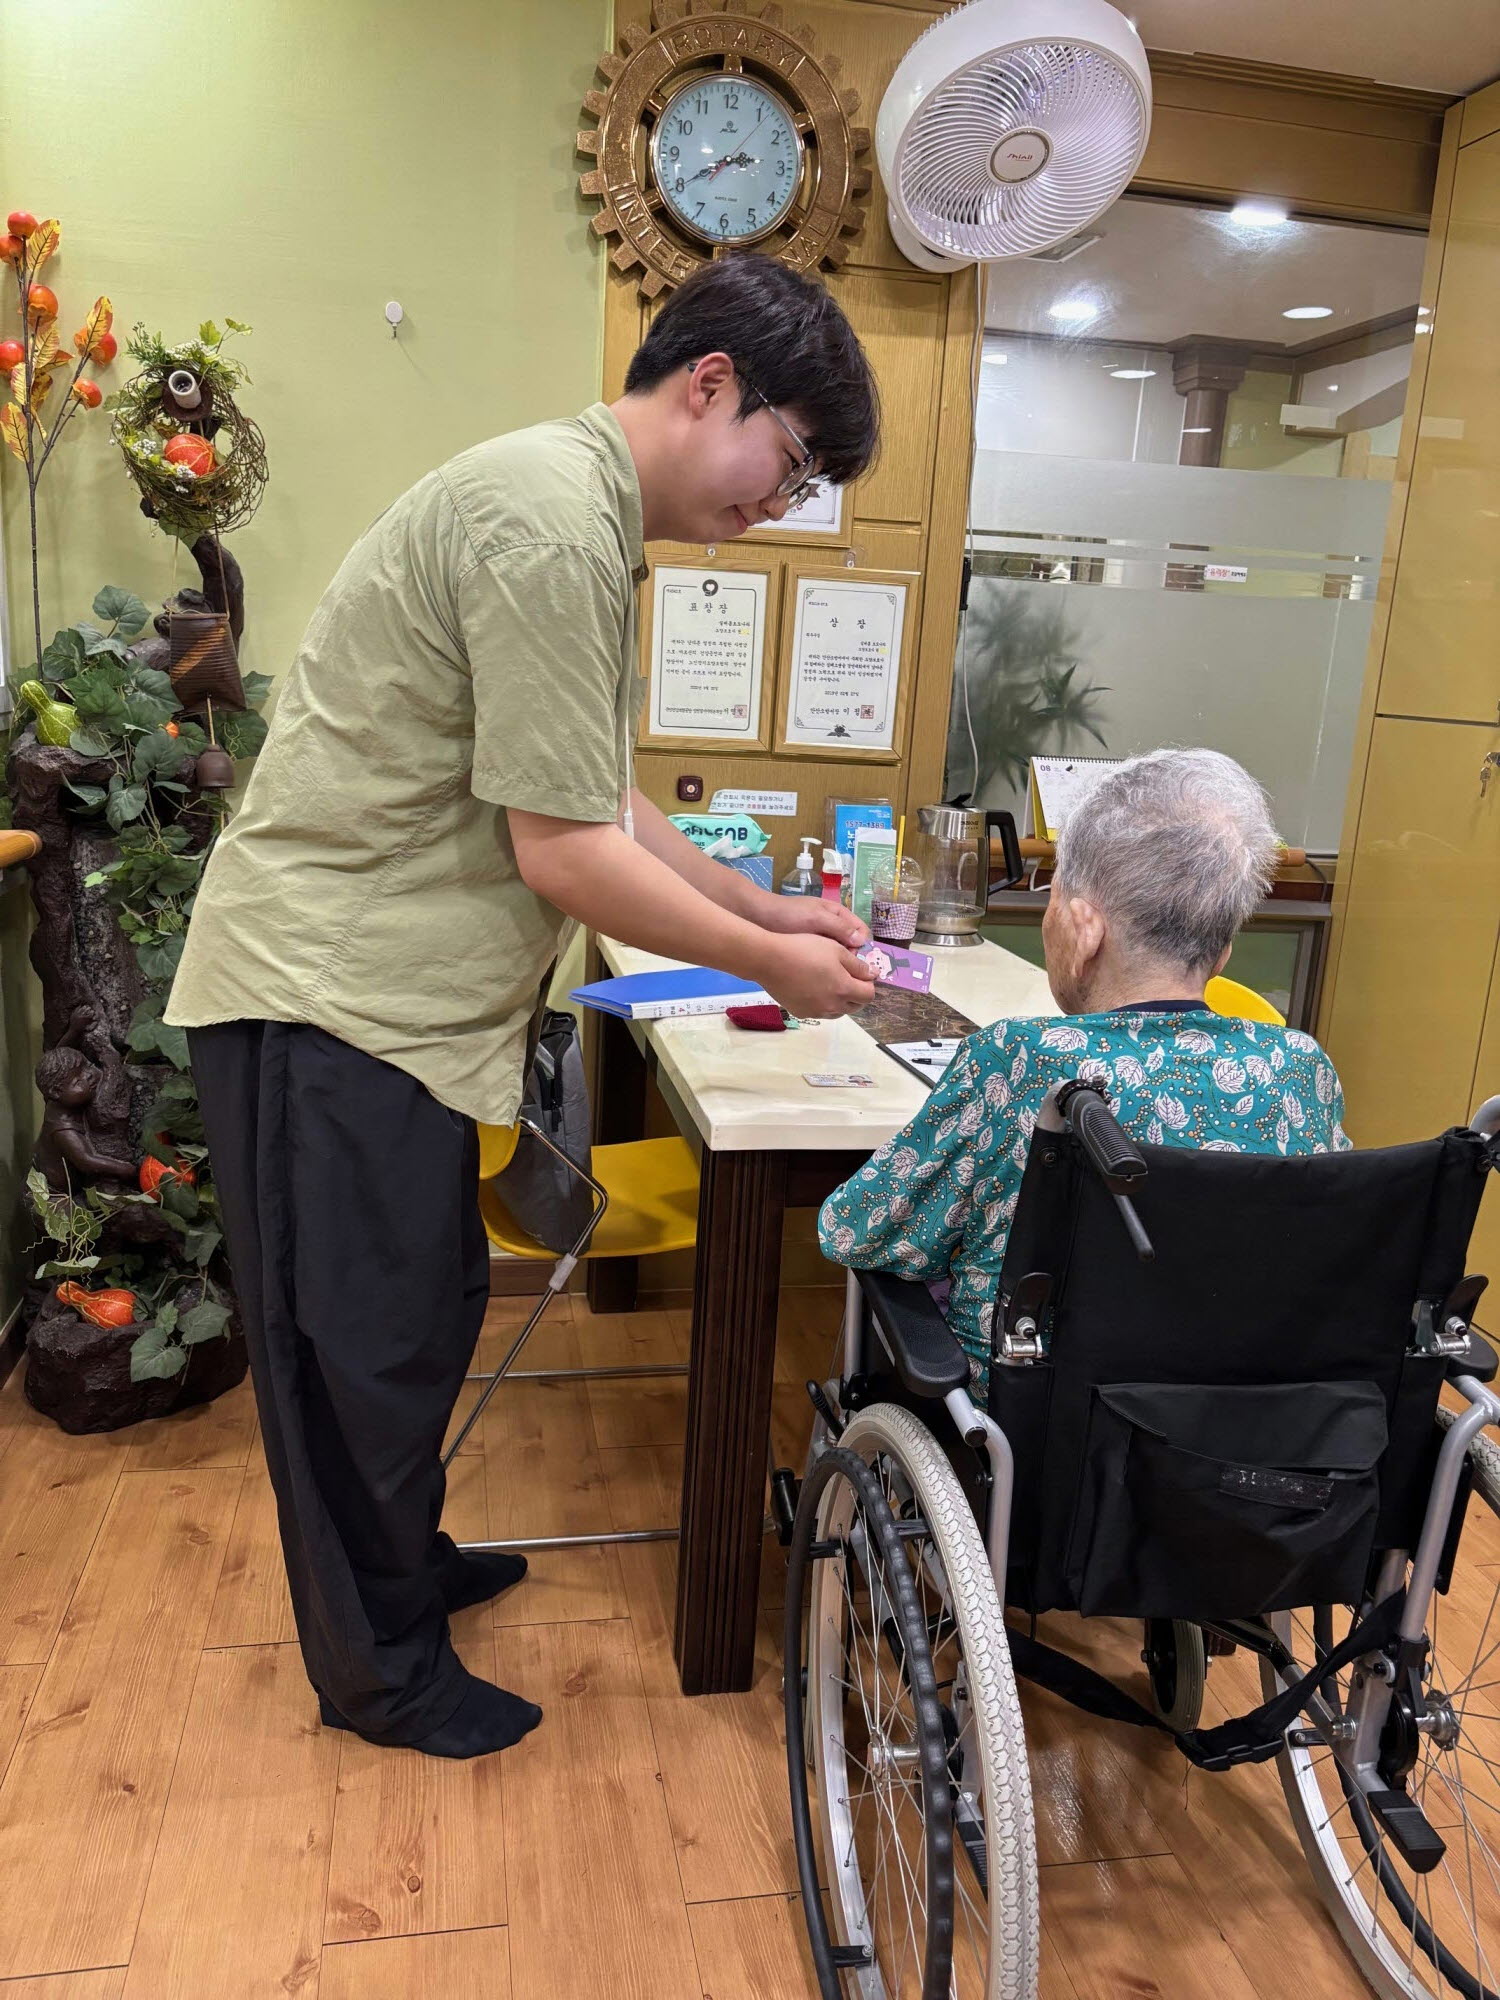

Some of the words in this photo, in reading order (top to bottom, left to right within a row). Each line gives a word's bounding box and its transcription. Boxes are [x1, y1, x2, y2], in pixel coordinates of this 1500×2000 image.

[672, 24, 797, 67] ROTARY
[696, 99, 708, 114] 11
[723, 94, 739, 110] 12
[756, 108, 763, 122] 1
[678, 119, 693, 135] 10
[771, 129, 780, 145] 2
[670, 146, 680, 161] 9
[775, 161, 785, 175] 3
[675, 177, 685, 193] 8
[766, 191, 776, 206] 4
[694, 202, 706, 217] 7
[746, 208, 756, 224] 5
[719, 213, 729, 228] 6
[845, 820, 885, 829] 1577-1389
